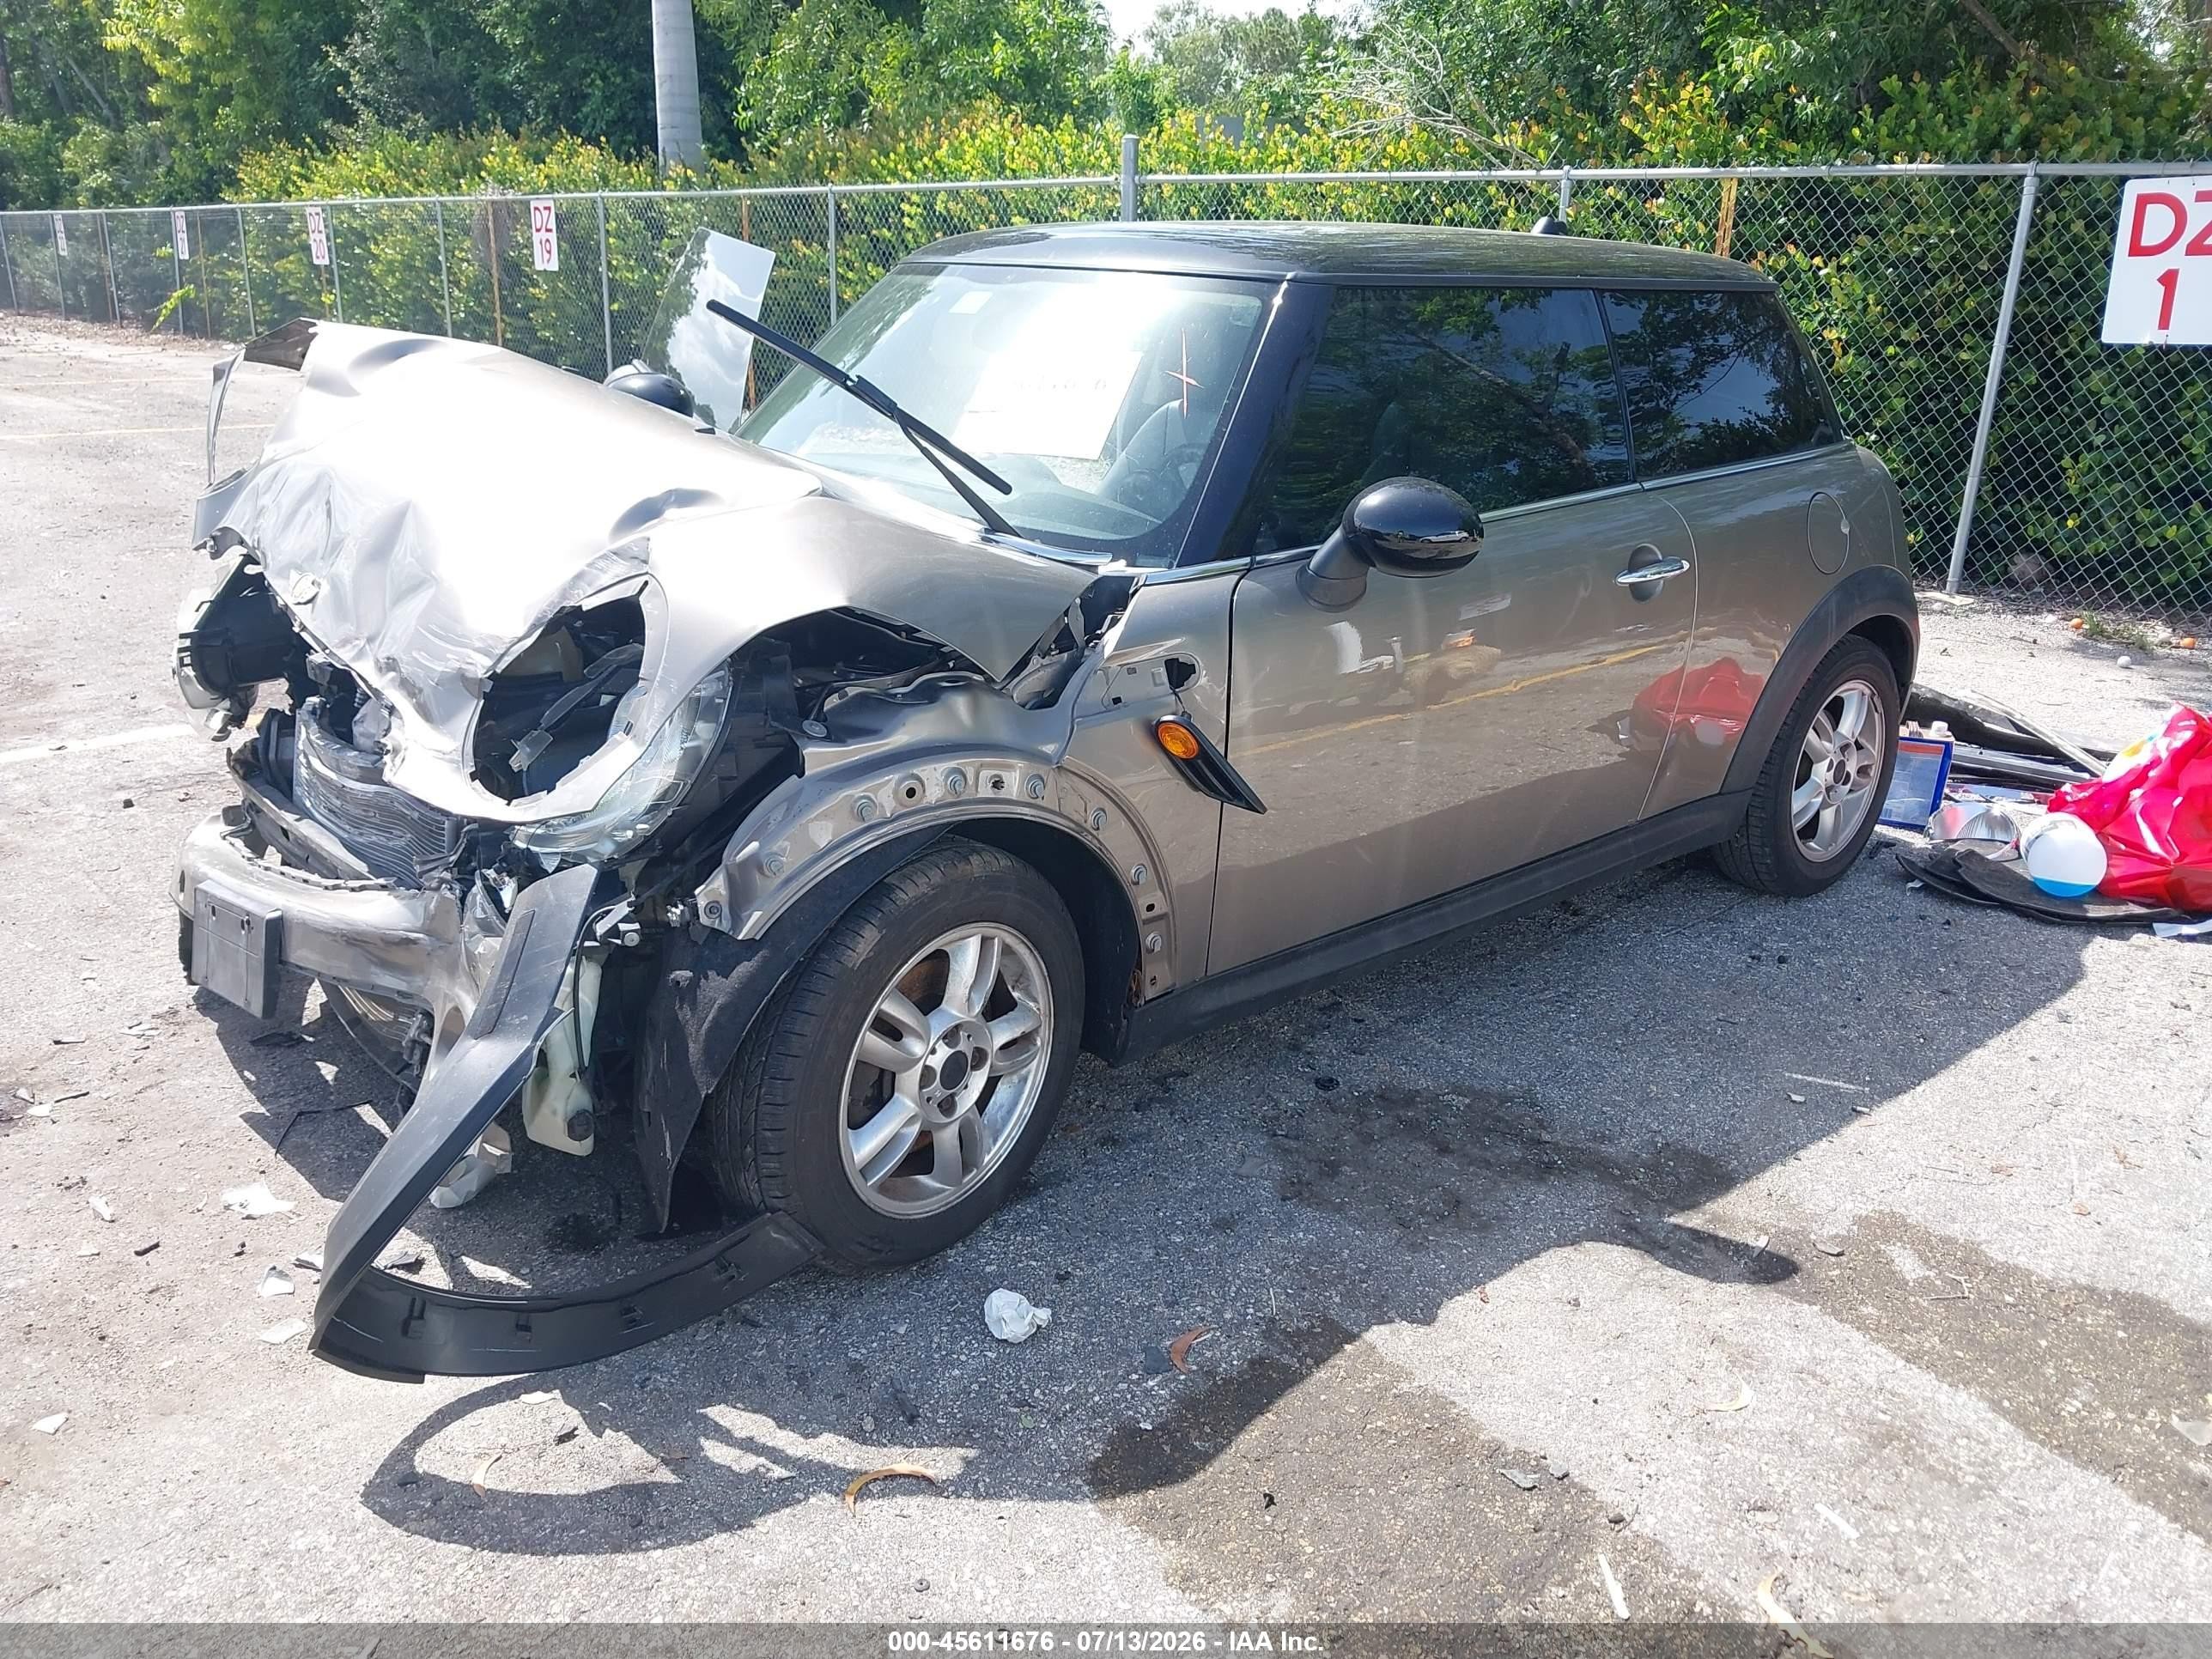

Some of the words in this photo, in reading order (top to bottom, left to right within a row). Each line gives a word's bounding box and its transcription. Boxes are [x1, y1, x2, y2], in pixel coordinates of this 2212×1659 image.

[176, 214, 185, 234] DZ
[309, 212, 323, 234] DZ
[533, 205, 553, 233] DZ
[313, 238, 325, 260] 20
[539, 237, 552, 264] 19
[2156, 268, 2180, 331] 1
